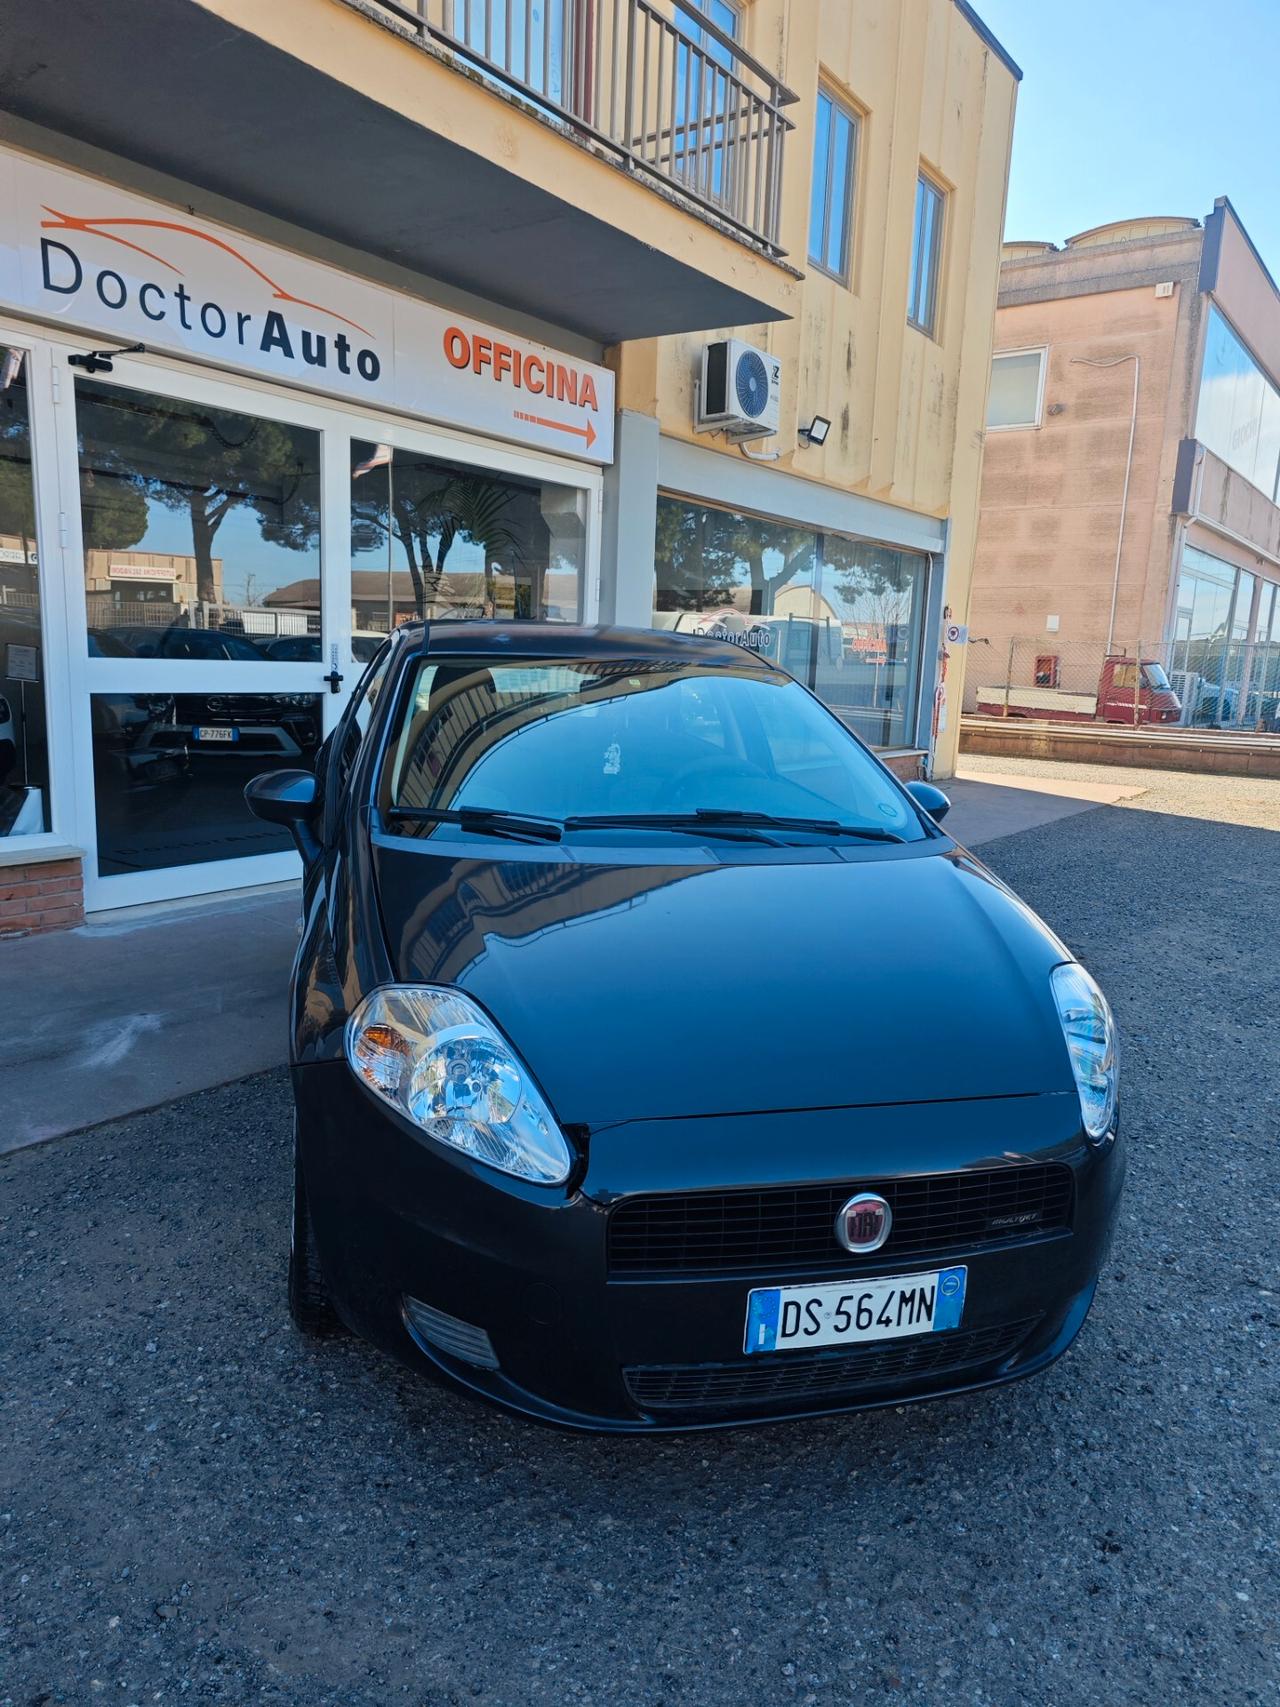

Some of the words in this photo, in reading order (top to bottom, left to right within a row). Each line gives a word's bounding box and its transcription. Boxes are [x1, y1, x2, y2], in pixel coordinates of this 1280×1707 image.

[442, 326, 599, 412] OFFICINA
[780, 1298, 823, 1338] DS
[833, 1285, 936, 1333] 564MN
